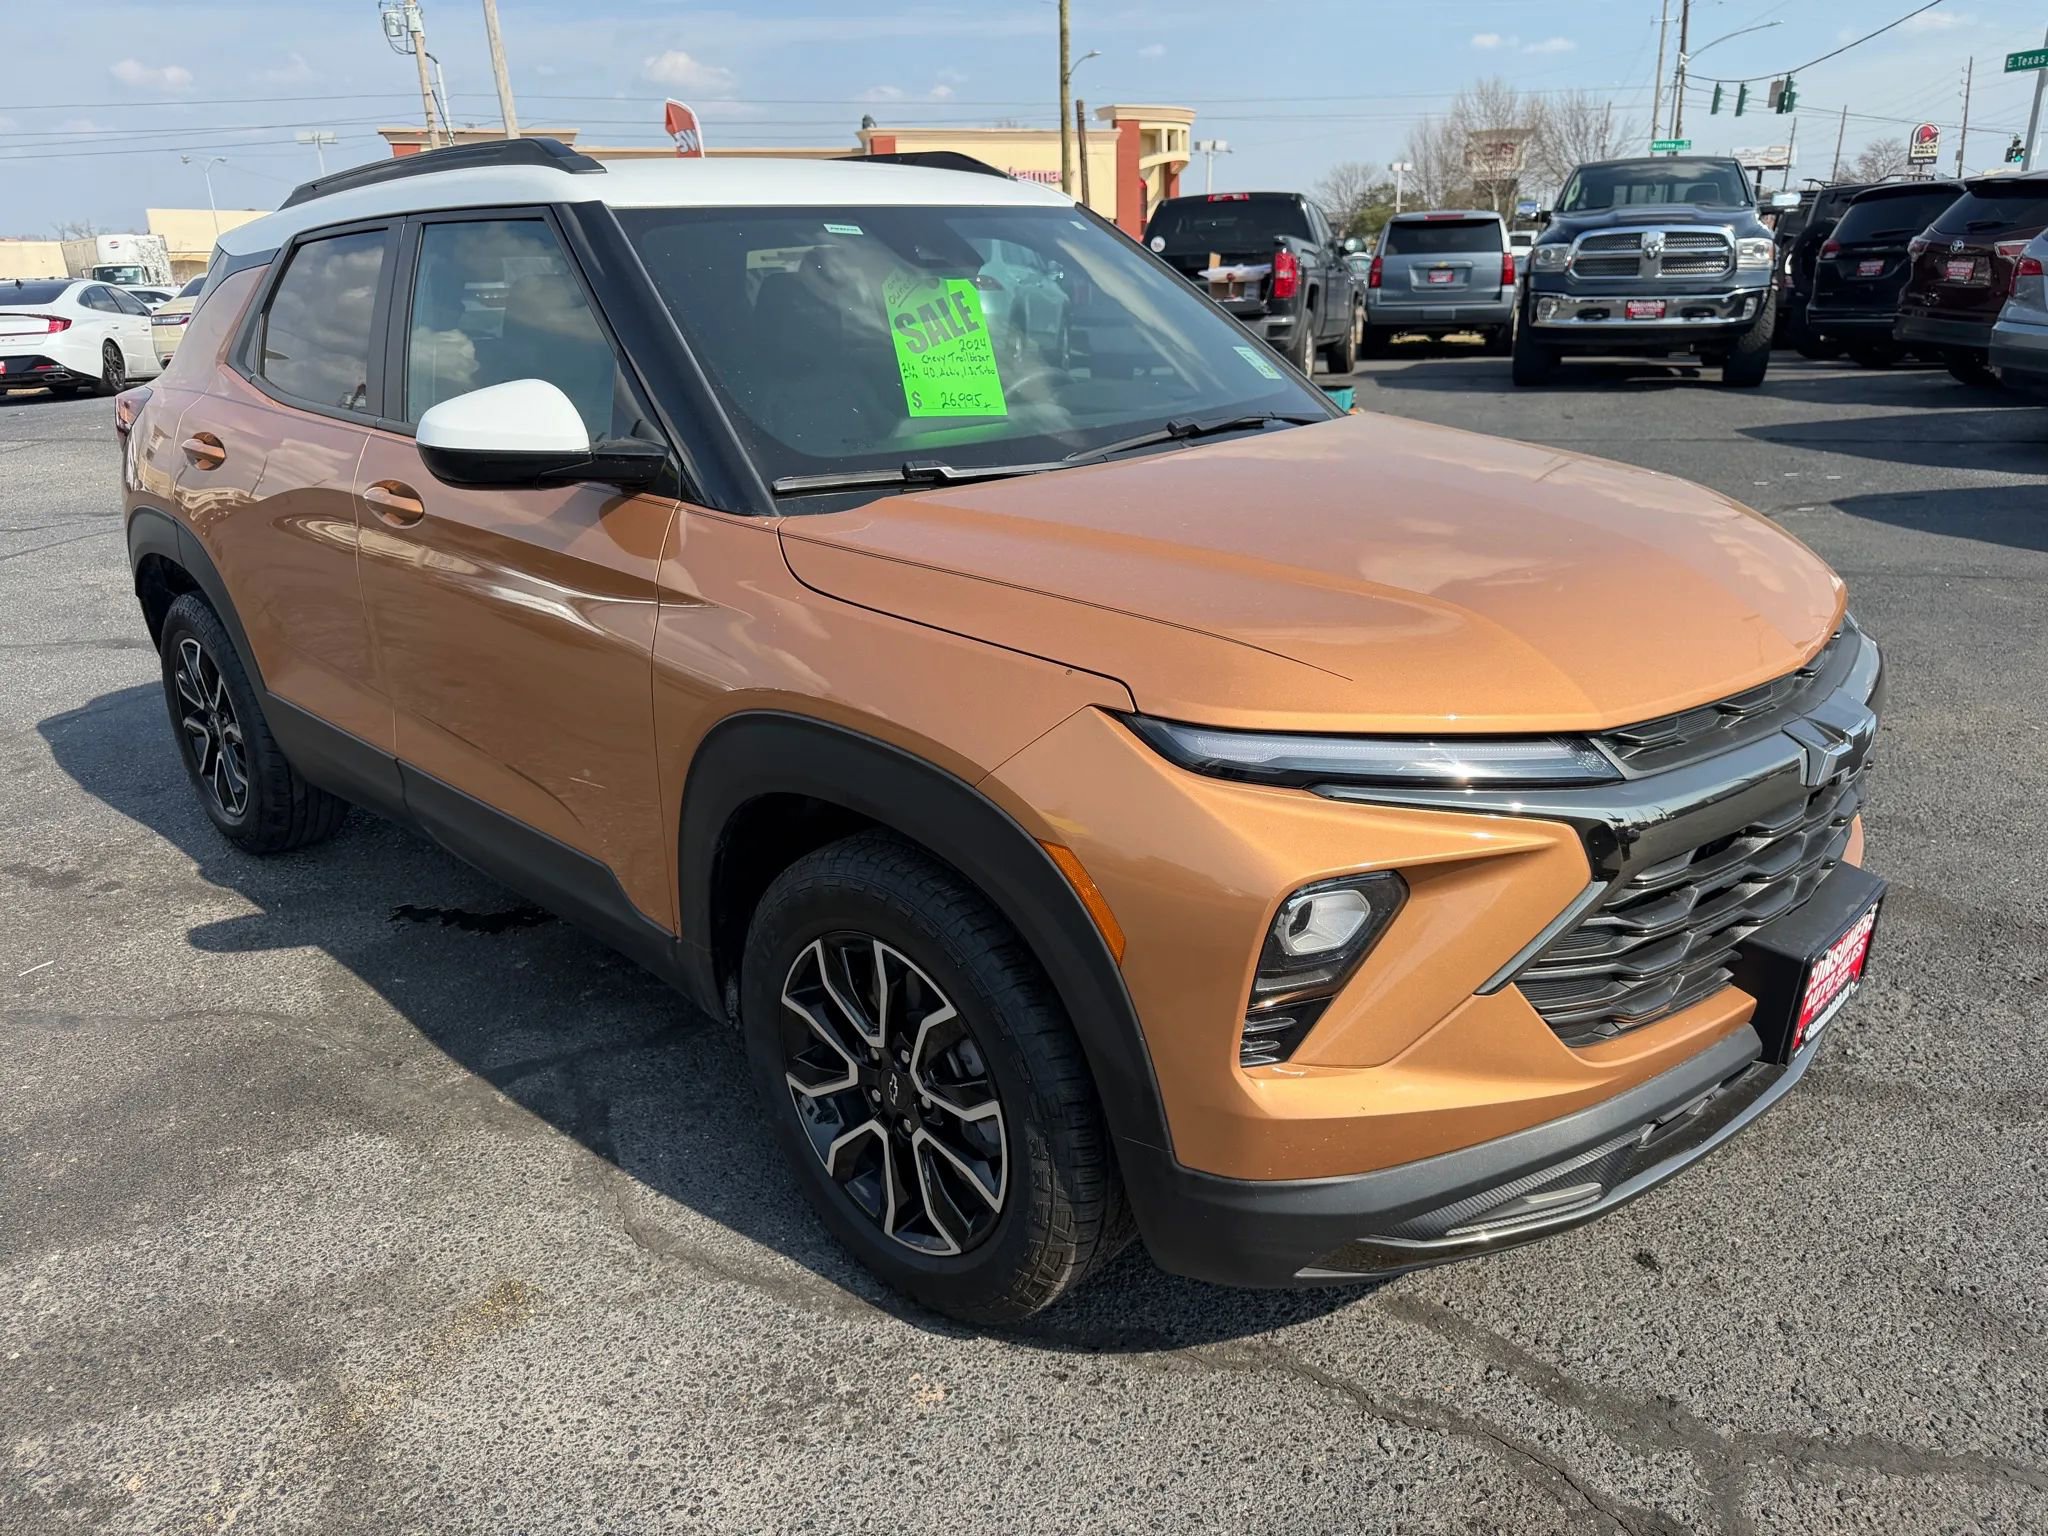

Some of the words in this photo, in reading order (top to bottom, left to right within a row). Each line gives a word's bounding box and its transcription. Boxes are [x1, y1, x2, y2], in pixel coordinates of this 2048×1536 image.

[894, 291, 980, 354] SALE
[959, 338, 986, 352] 2024
[911, 391, 922, 409] $
[1804, 971, 1837, 1014] AUTO
